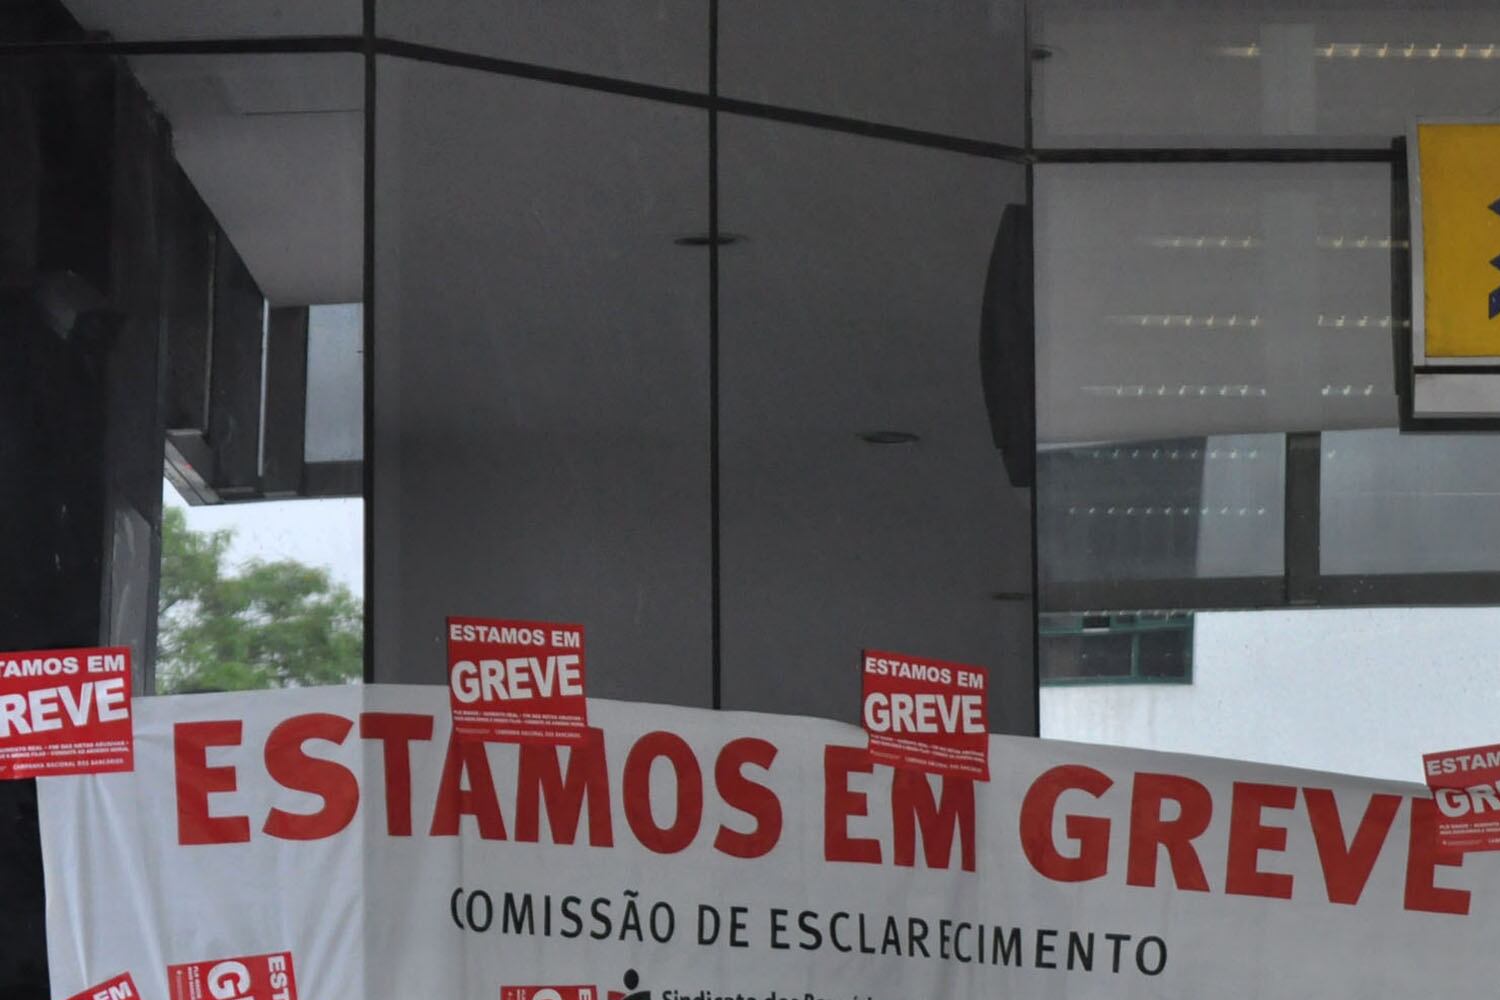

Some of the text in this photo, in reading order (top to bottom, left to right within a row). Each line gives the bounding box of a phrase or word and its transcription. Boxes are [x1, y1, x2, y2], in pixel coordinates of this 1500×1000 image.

[450, 624, 580, 648] ESTAMOS EM
[87, 654, 125, 673] EM
[451, 654, 583, 703] GREVE
[865, 657, 984, 689] ESTAMOS EM
[864, 692, 986, 733] GREVE
[174, 712, 1471, 915] ESTAMOS EM GREVE
[451, 887, 1168, 976] COMISSÃO DE ESCLARECIMENTO
